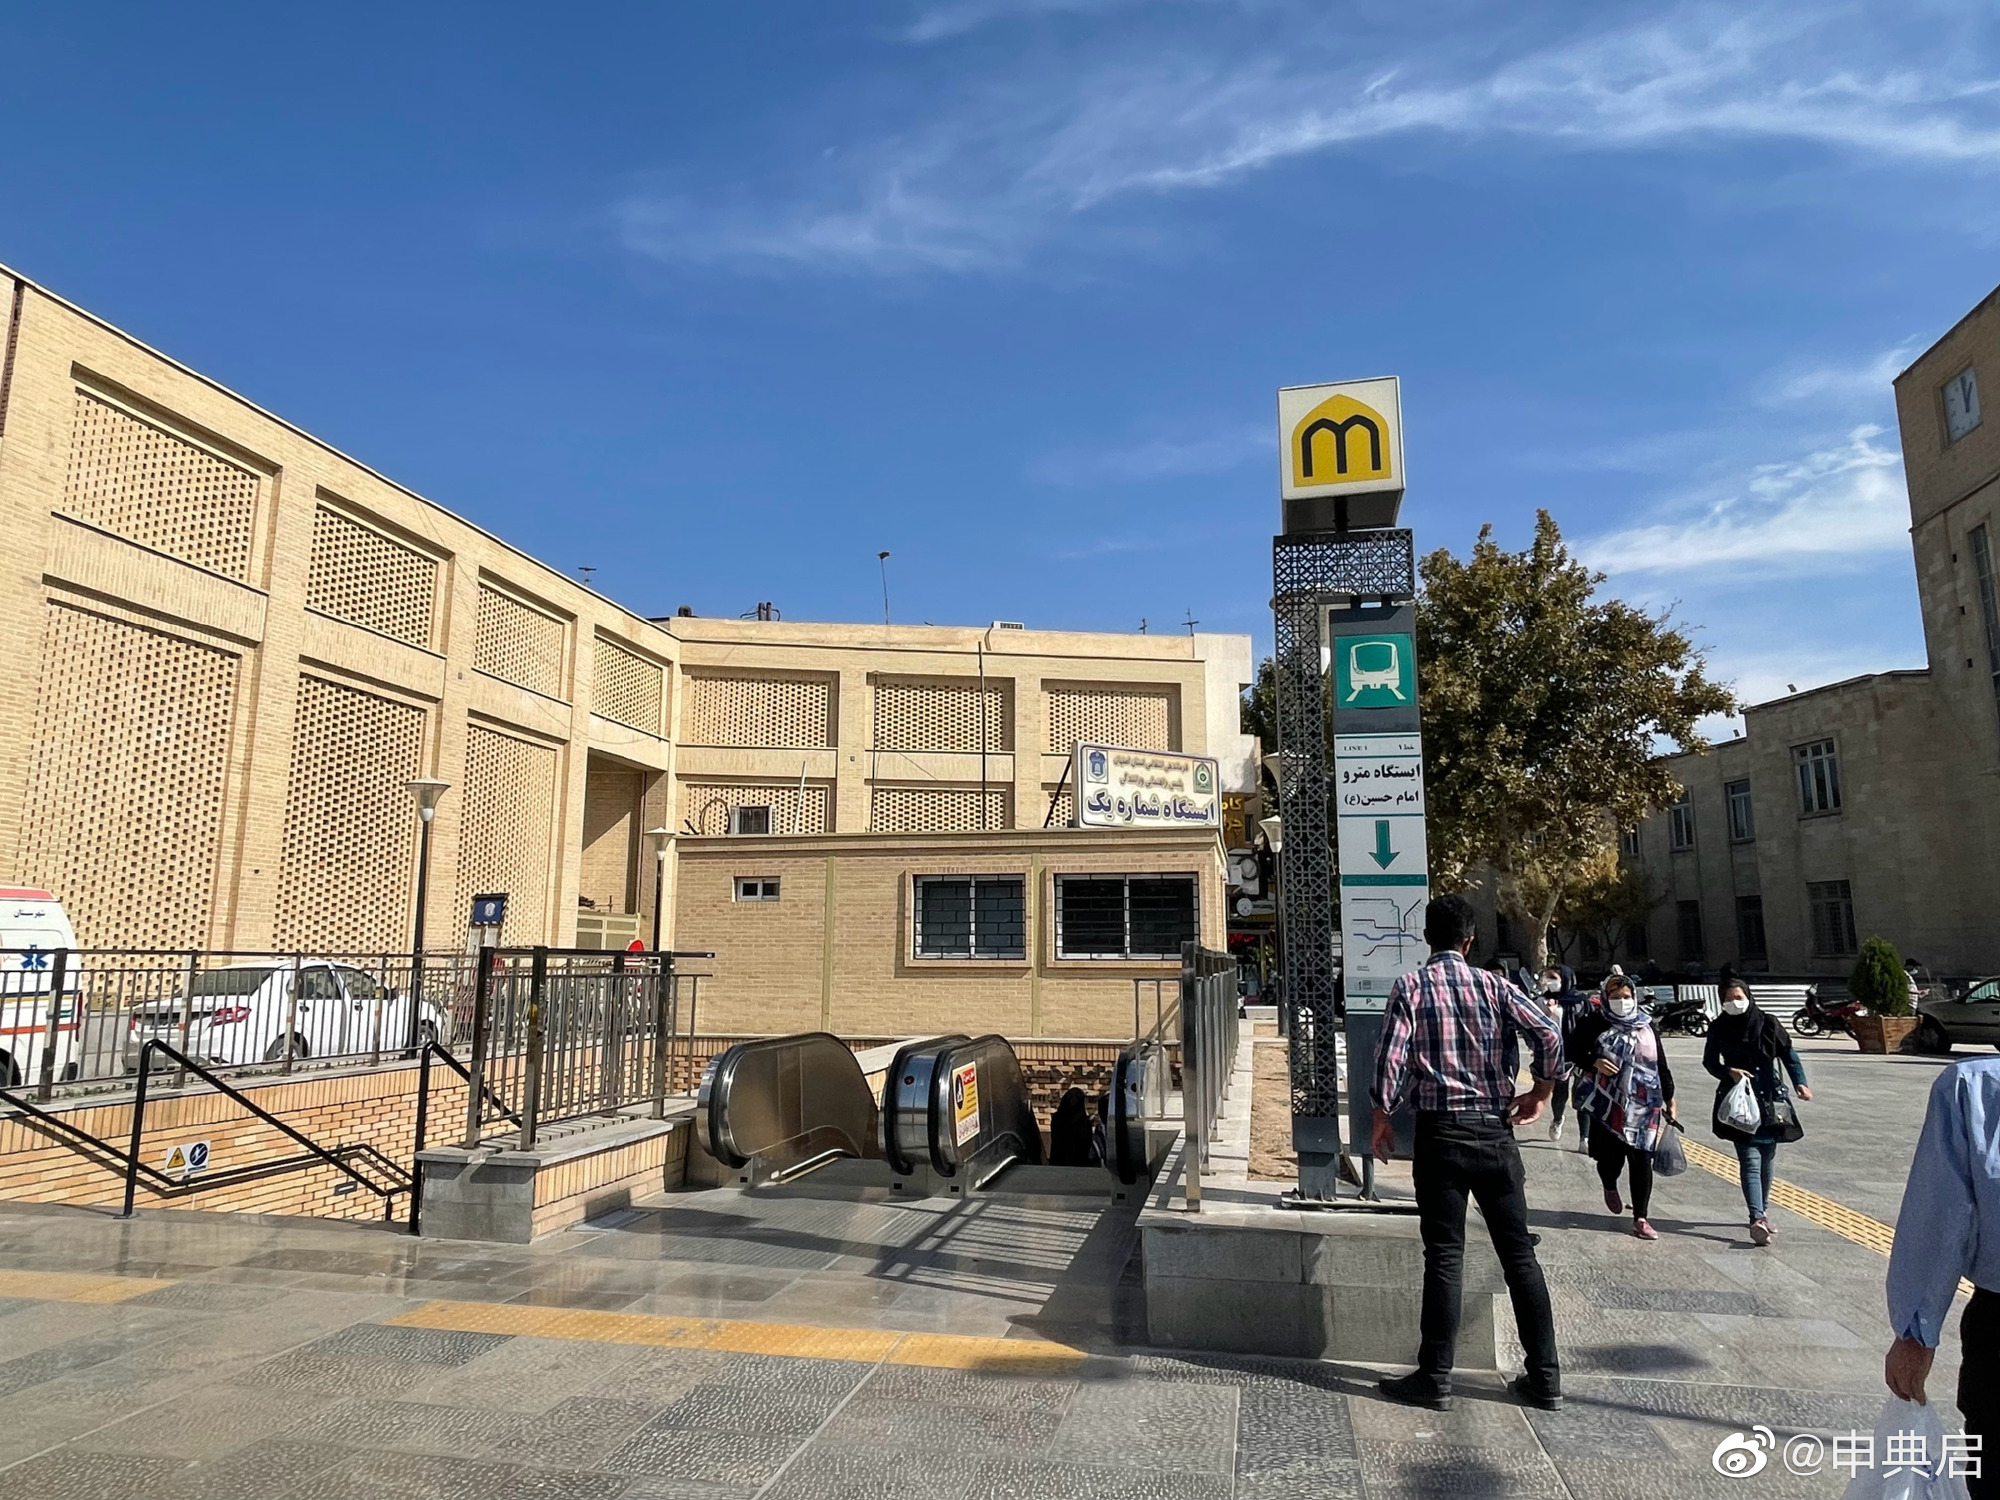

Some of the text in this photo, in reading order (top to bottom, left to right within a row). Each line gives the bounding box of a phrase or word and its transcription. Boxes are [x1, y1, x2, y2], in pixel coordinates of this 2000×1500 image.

[1342, 763, 1420, 783] ایستگاه مترو
[1396, 790, 1419, 806] امام
[1088, 792, 1215, 825] ایستگاه شماره یک
